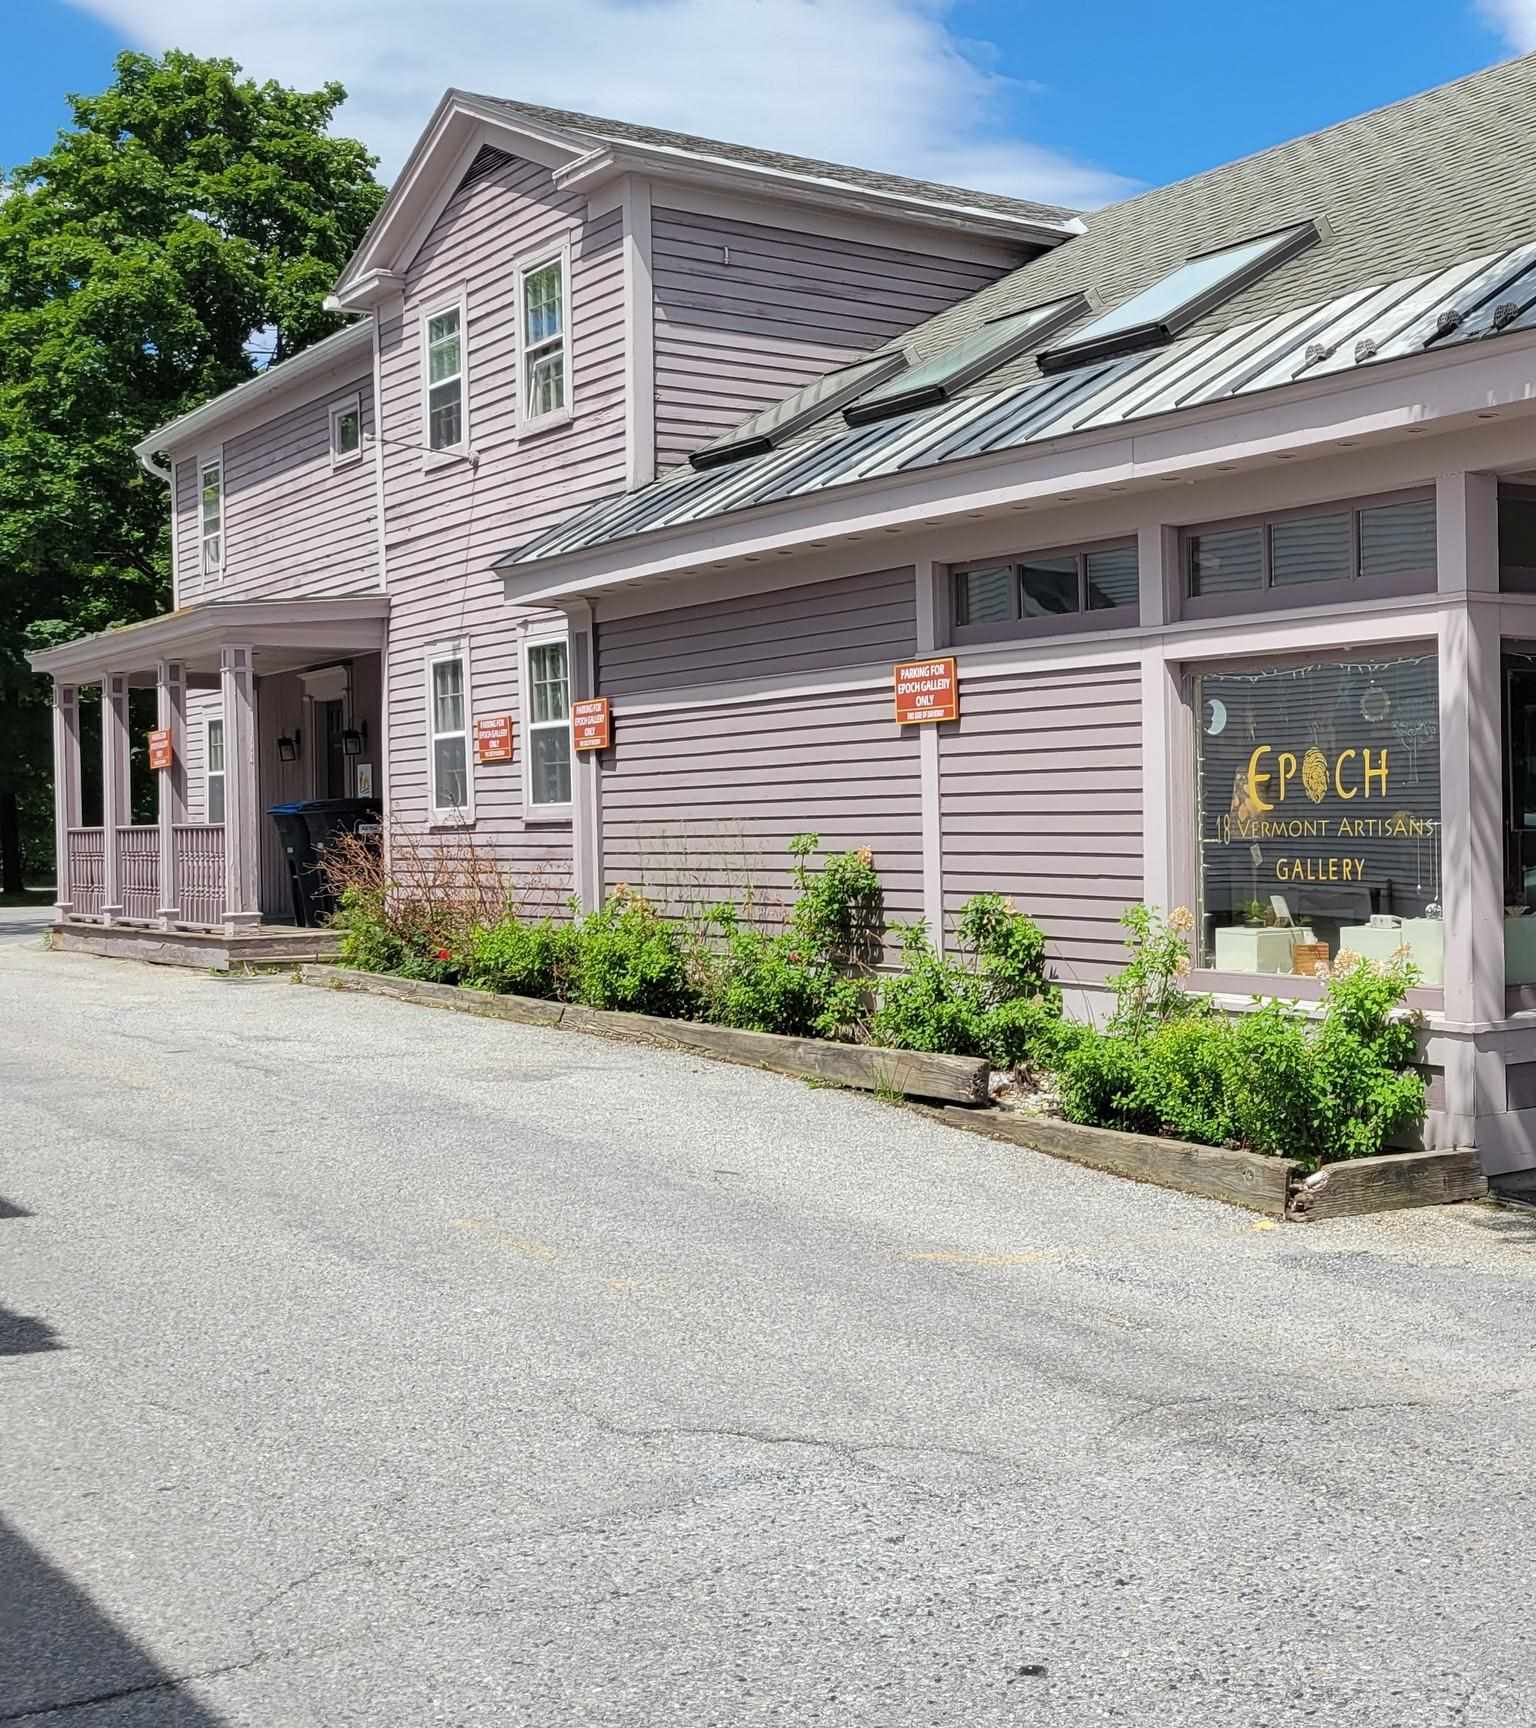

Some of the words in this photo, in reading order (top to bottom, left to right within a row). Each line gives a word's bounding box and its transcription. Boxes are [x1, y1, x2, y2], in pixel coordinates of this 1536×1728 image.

[900, 666, 929, 680] PARKING
[930, 664, 944, 675] FOR
[898, 682, 920, 694] EPOCH
[921, 679, 950, 691] GALLERY
[916, 695, 935, 706] ONLY
[1248, 744, 1389, 811] EPOCH
[1216, 814, 1231, 845] 18
[1237, 818, 1330, 838] VERMONT
[1337, 817, 1434, 838] ARTISANS
[1276, 858, 1366, 881] GALLERY
